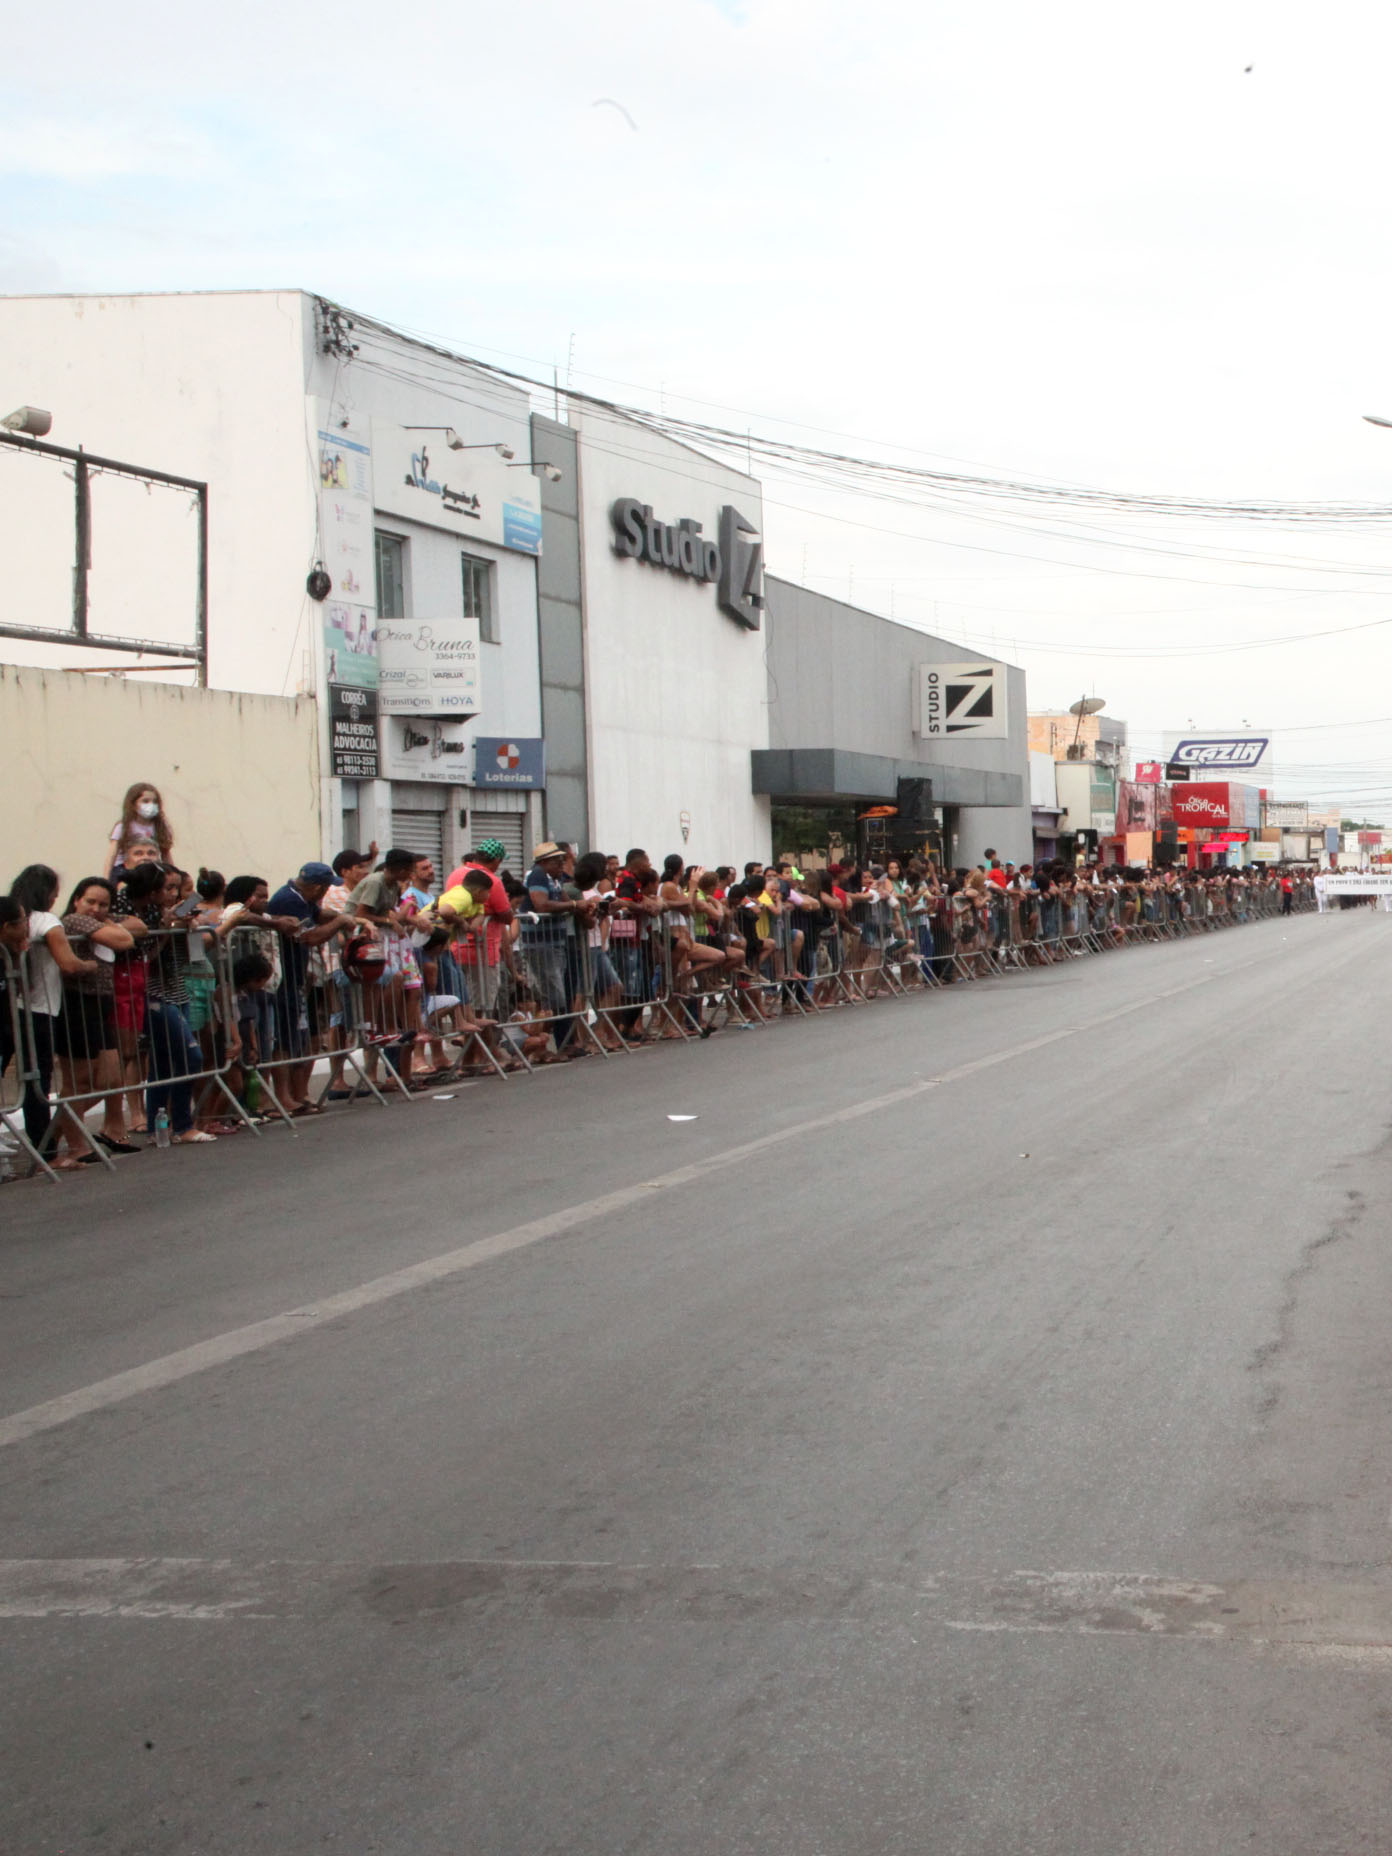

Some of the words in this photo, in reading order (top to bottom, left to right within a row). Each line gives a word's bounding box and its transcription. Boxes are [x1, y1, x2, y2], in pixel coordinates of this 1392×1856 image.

[615, 497, 722, 583] Studio
[413, 625, 475, 651] Bruna
[379, 671, 406, 679] Crizal
[382, 697, 432, 706] Transitions
[440, 696, 474, 705] HOYA
[928, 672, 940, 733] STUDIO
[335, 721, 375, 736] MALHEIROS
[333, 735, 378, 751] ADVOCACIA
[1178, 742, 1263, 764] GAZIN
[485, 773, 533, 783] Loterias
[1176, 803, 1228, 815] TROPICAL
